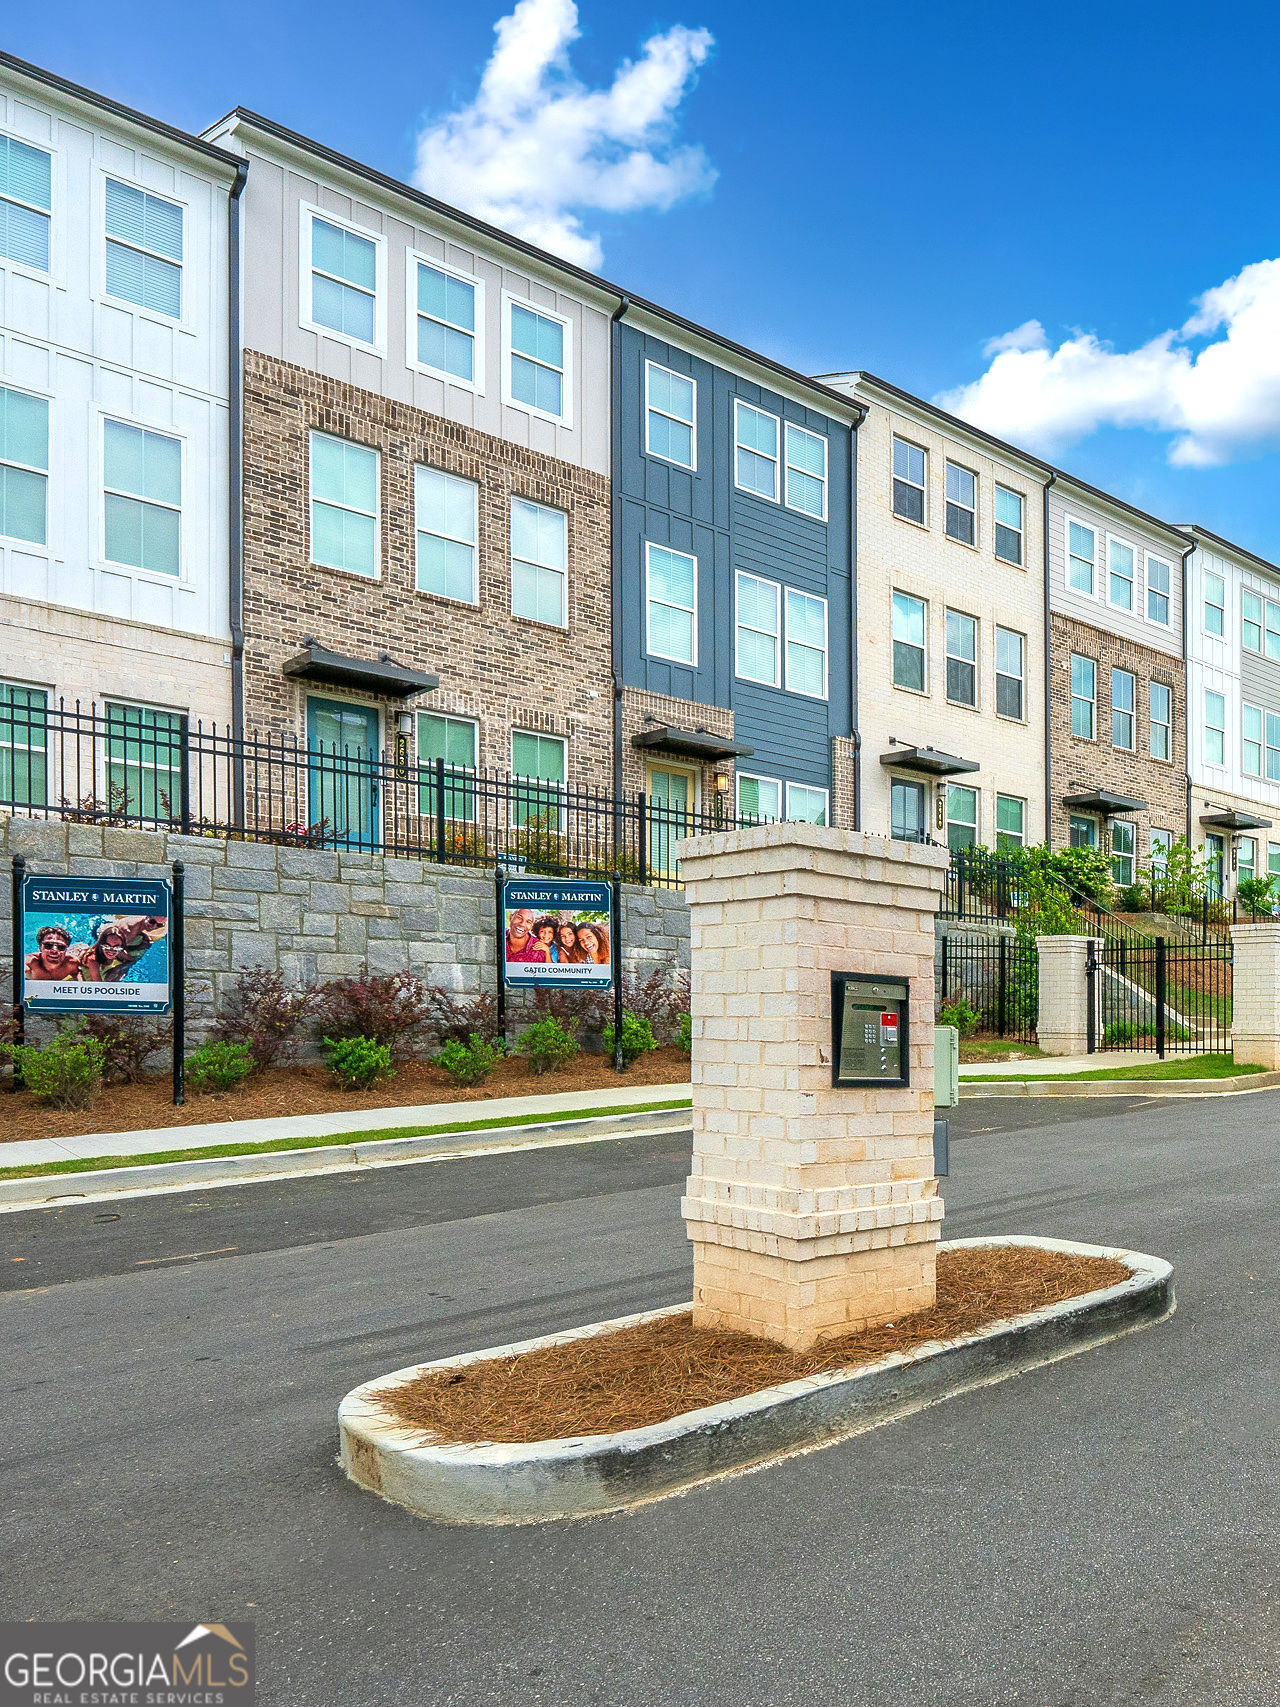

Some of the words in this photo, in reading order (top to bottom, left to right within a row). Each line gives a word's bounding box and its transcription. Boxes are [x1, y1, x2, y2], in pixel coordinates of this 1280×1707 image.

[32, 890, 89, 902] STANLEY
[103, 893, 157, 904] MARTIN
[510, 891, 552, 900] STANLEY
[561, 892, 602, 902] MARTIN
[523, 966, 547, 974] GATED
[547, 967, 593, 975] COMMUNITY
[53, 986, 79, 995] MEET
[80, 986, 92, 995] US
[94, 987, 141, 996] POOLSIDE
